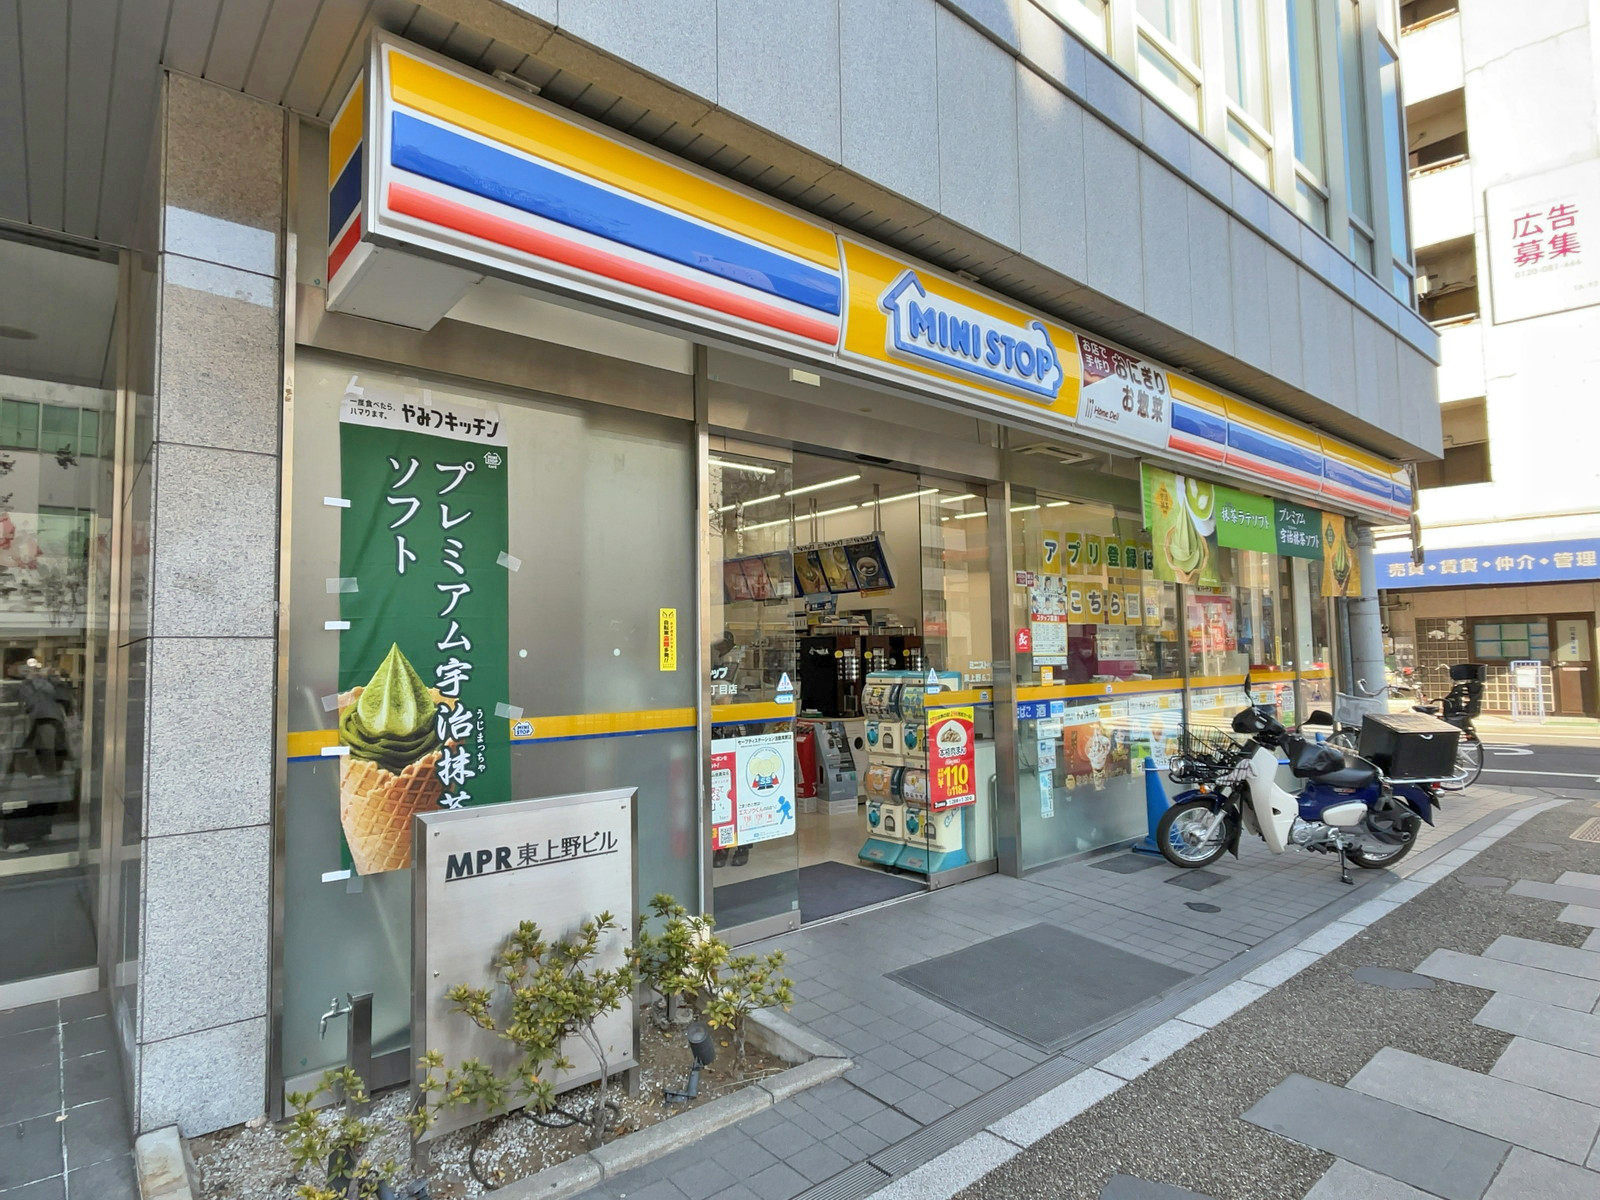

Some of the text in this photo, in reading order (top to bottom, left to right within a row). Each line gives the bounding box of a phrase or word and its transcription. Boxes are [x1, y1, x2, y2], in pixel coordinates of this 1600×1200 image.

[1512, 204, 1579, 240] 広告
[1512, 232, 1581, 267] 募集
[908, 300, 1053, 381] MINI STOP
[1082, 339, 1107, 359] お店で
[1085, 353, 1110, 373] 手作り
[1112, 353, 1165, 395] おにぎり
[350, 398, 396, 412] 一度食べたら、
[350, 407, 388, 420] ハマります。
[1093, 405, 1109, 418] Home
[1122, 385, 1164, 422] お惣菜
[401, 403, 500, 438] やみつキッチン
[387, 457, 420, 575] ソフト
[1221, 506, 1270, 529] 抹茶ラテソフト
[1279, 508, 1306, 525] プレミアム
[1280, 528, 1320, 549] 宇治抹茶ソフト
[1044, 540, 1153, 570] アプリ登録は
[1071, 591, 1121, 615] こちら
[710, 684, 738, 695] 丁目店
[1036, 704, 1047, 718] 酒
[476, 708, 486, 773] うじまっちゃ
[445, 830, 619, 879] MPR 東上野ビル
